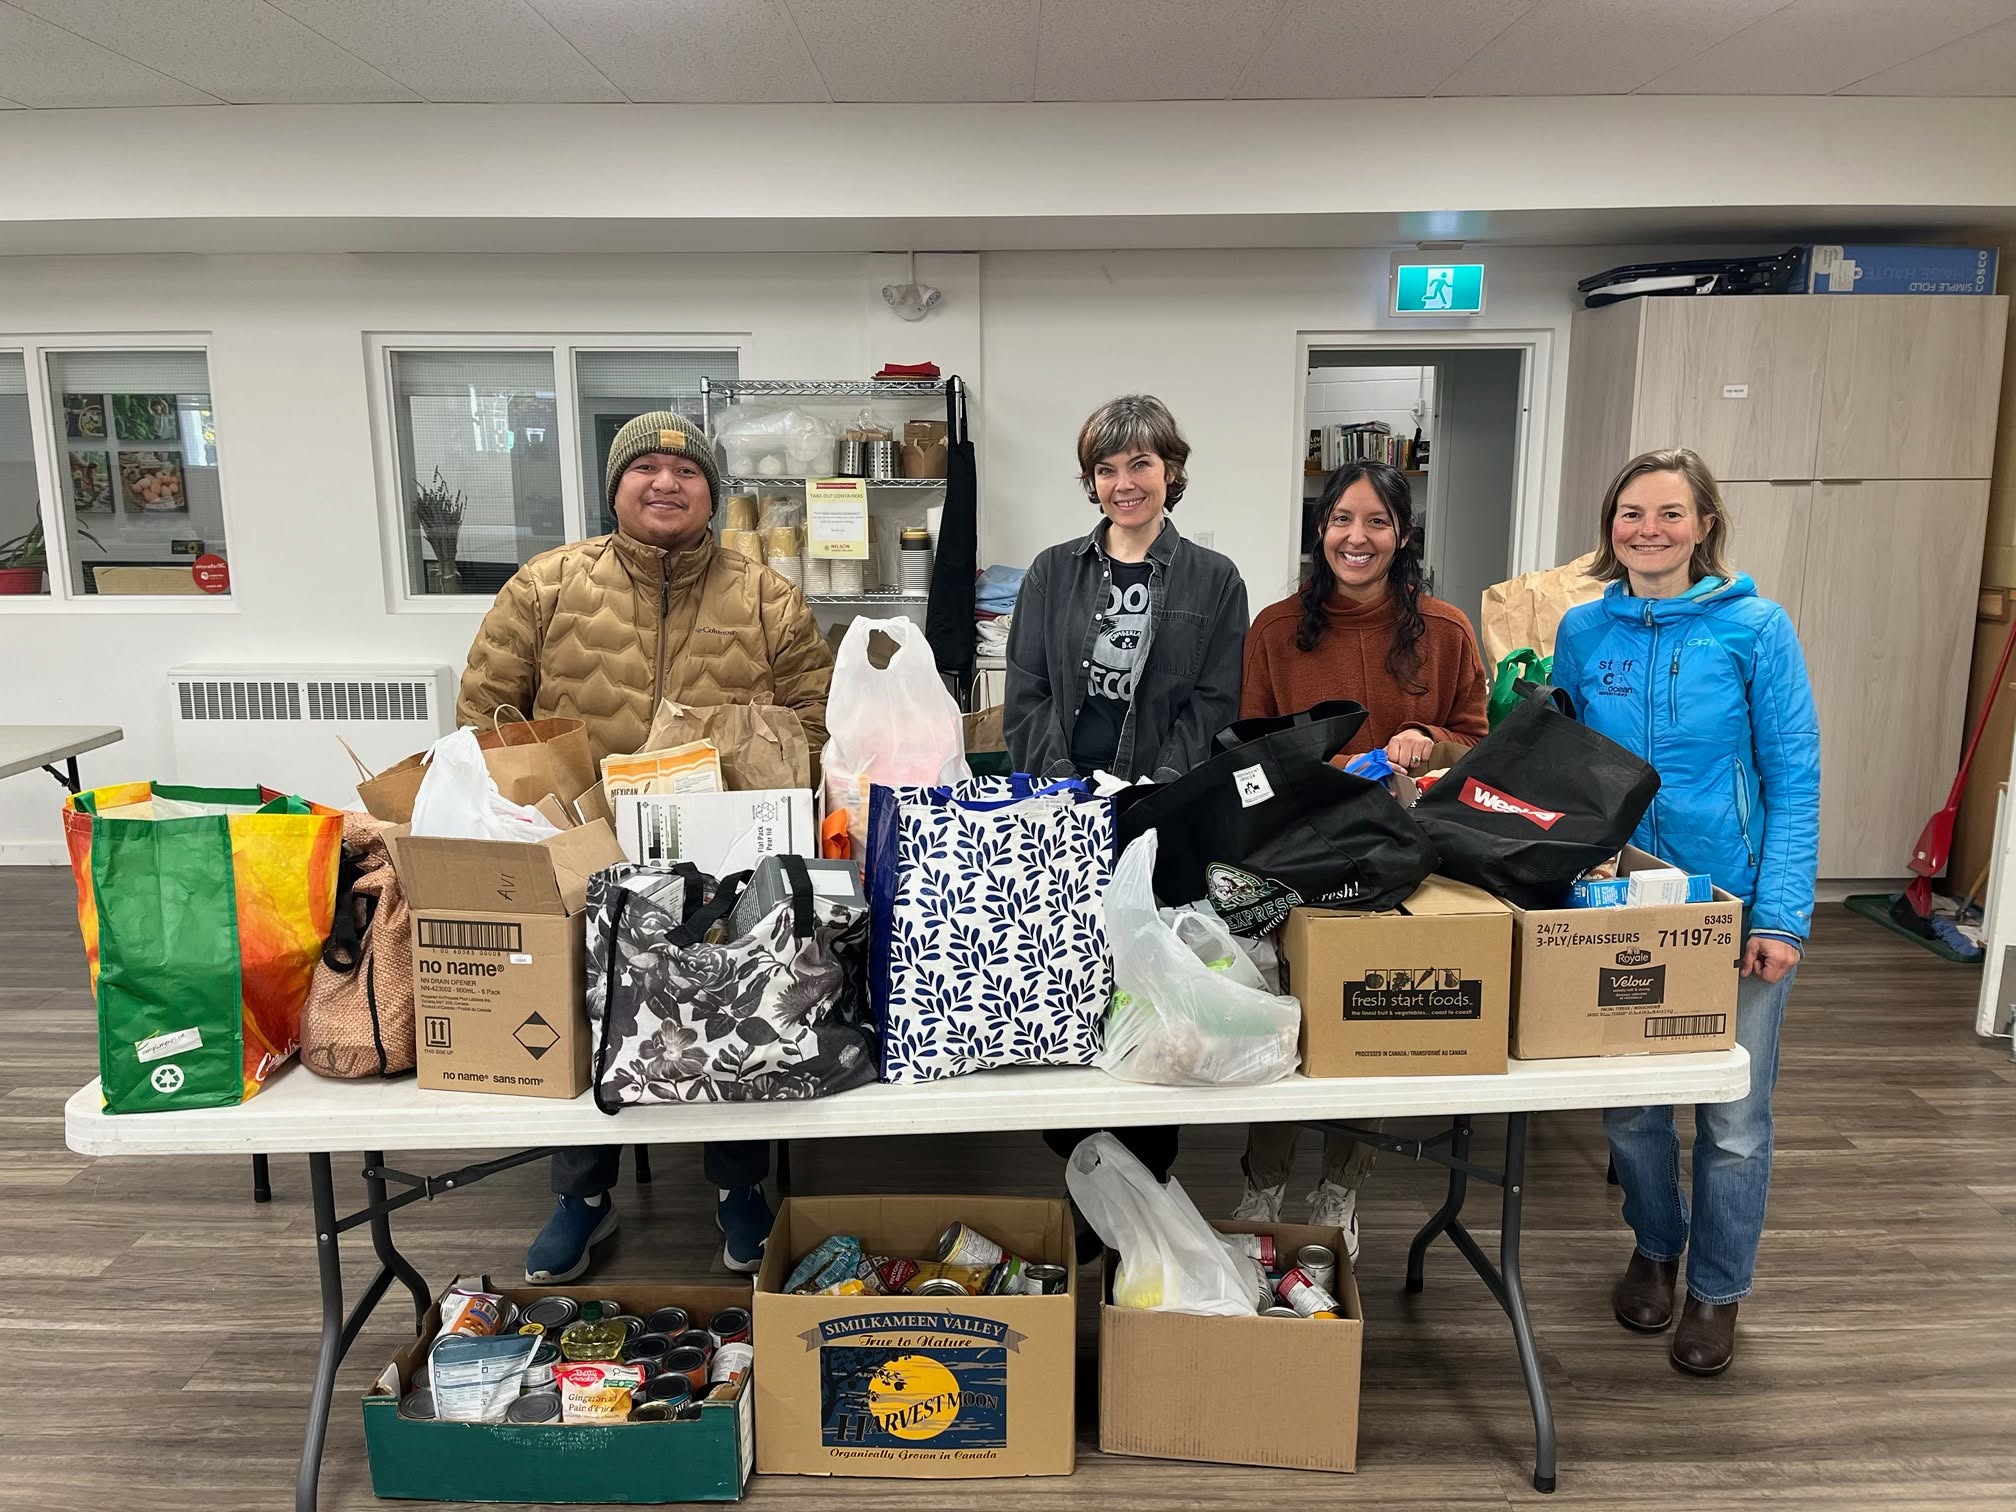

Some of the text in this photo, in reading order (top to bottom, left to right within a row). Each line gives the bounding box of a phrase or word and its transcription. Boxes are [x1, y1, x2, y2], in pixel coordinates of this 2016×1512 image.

[1975, 250, 1988, 293] COSCO
[1909, 282, 1973, 292] SIMPLE FOLD
[610, 787, 639, 799] MEXICAN
[1320, 881, 1360, 902] resh!
[1224, 892, 1300, 930] EXPRESS
[1704, 914, 1733, 925] 63435
[1536, 923, 1570, 934] 24/72
[1536, 933, 1640, 947] 3-PLY/ÉPAISSEURS
[1658, 928, 1732, 947] 71197-26
[1618, 953, 1649, 964] Royale
[419, 959, 442, 974] no
[1610, 975, 1654, 988] Velour
[420, 985, 452, 993] NN-423002
[487, 988, 501, 996] Pack
[1351, 990, 1386, 1007] fresh
[1391, 993, 1424, 1008] start
[443, 1072, 455, 1080] no
[493, 1075, 516, 1084] sans
[825, 1315, 1004, 1337] SIMILKAMEEN VALLEY
[858, 1334, 973, 1347] True to Nature
[834, 1390, 998, 1442] HARVEST MOON
[829, 1448, 998, 1461] Organically Grown in Canada
